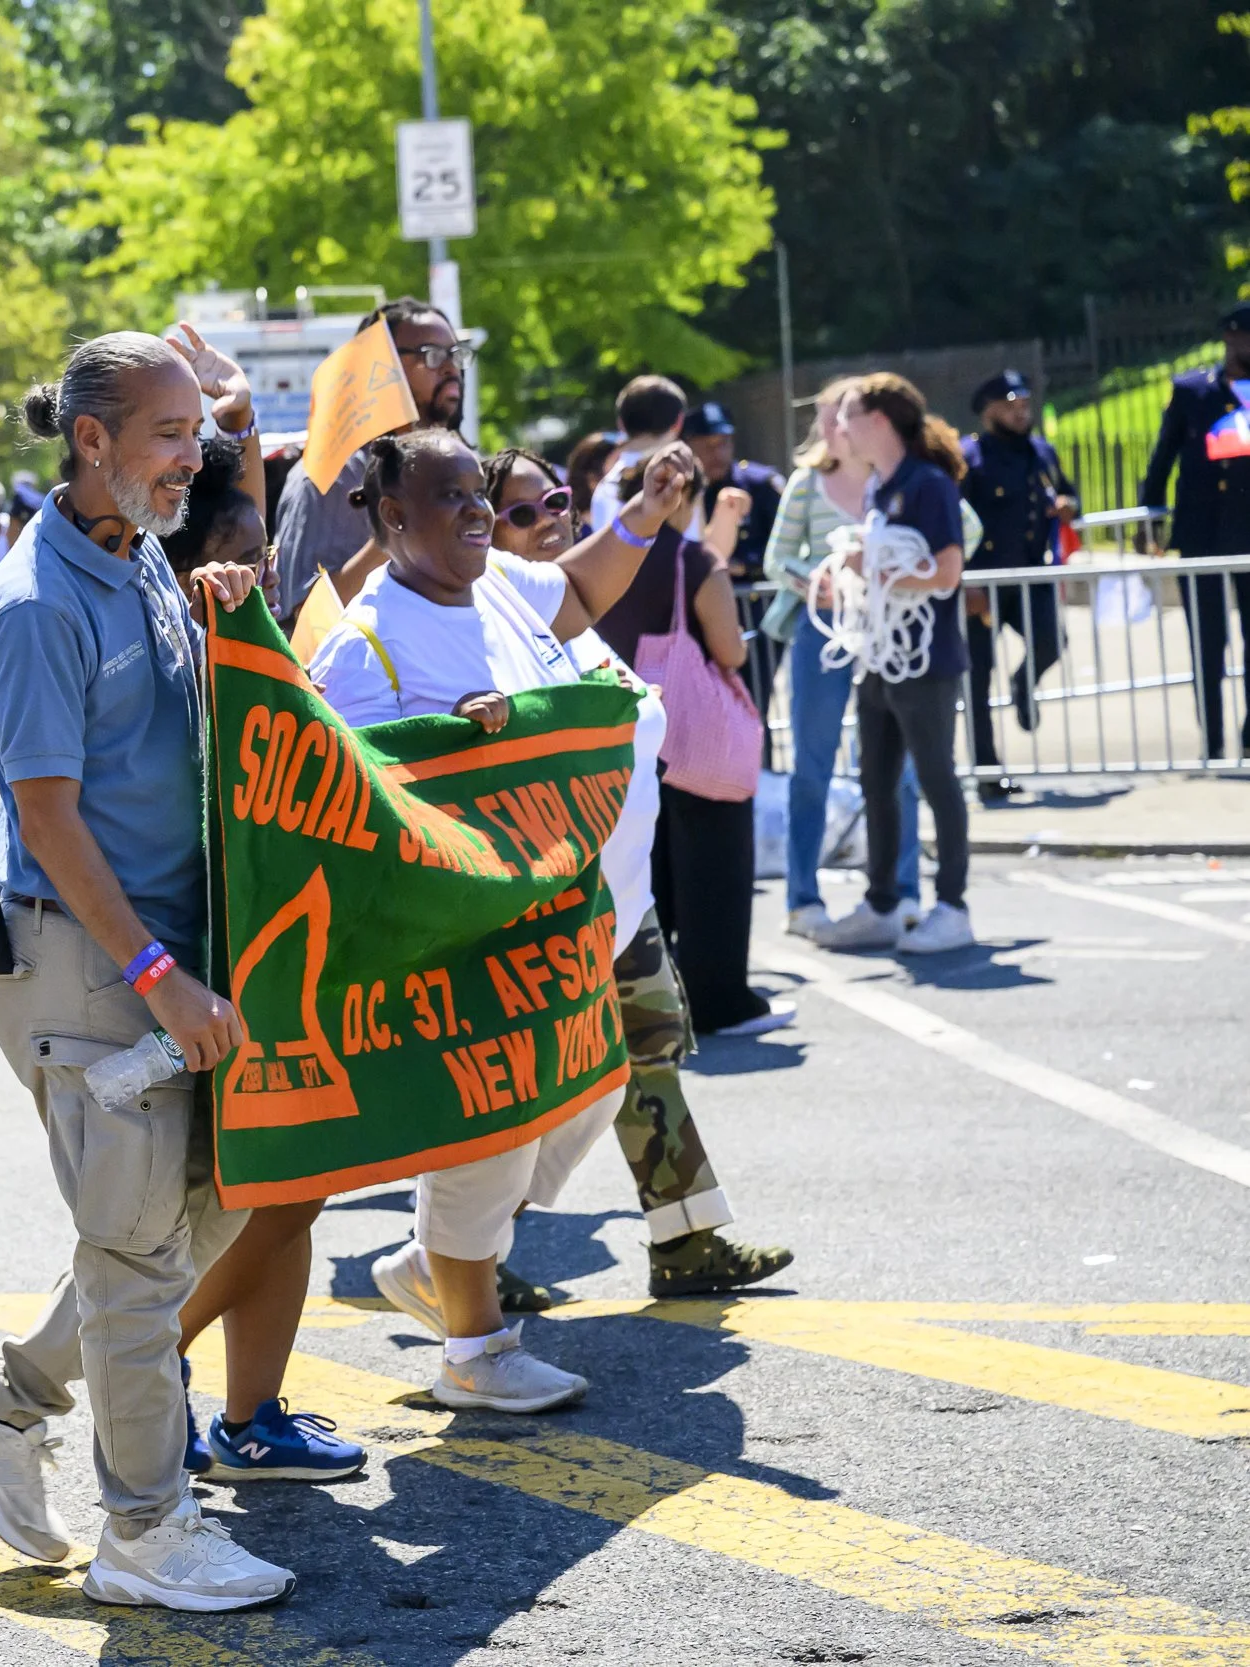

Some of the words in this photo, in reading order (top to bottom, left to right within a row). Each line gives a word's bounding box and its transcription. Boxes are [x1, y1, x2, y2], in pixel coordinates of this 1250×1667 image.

[412, 169, 461, 201] 25
[233, 704, 379, 851] SOCIAL
[343, 980, 402, 1056] D.C.
[405, 967, 473, 1041] 37,
[442, 1028, 539, 1119] NEW
[554, 997, 609, 1087] YORK
